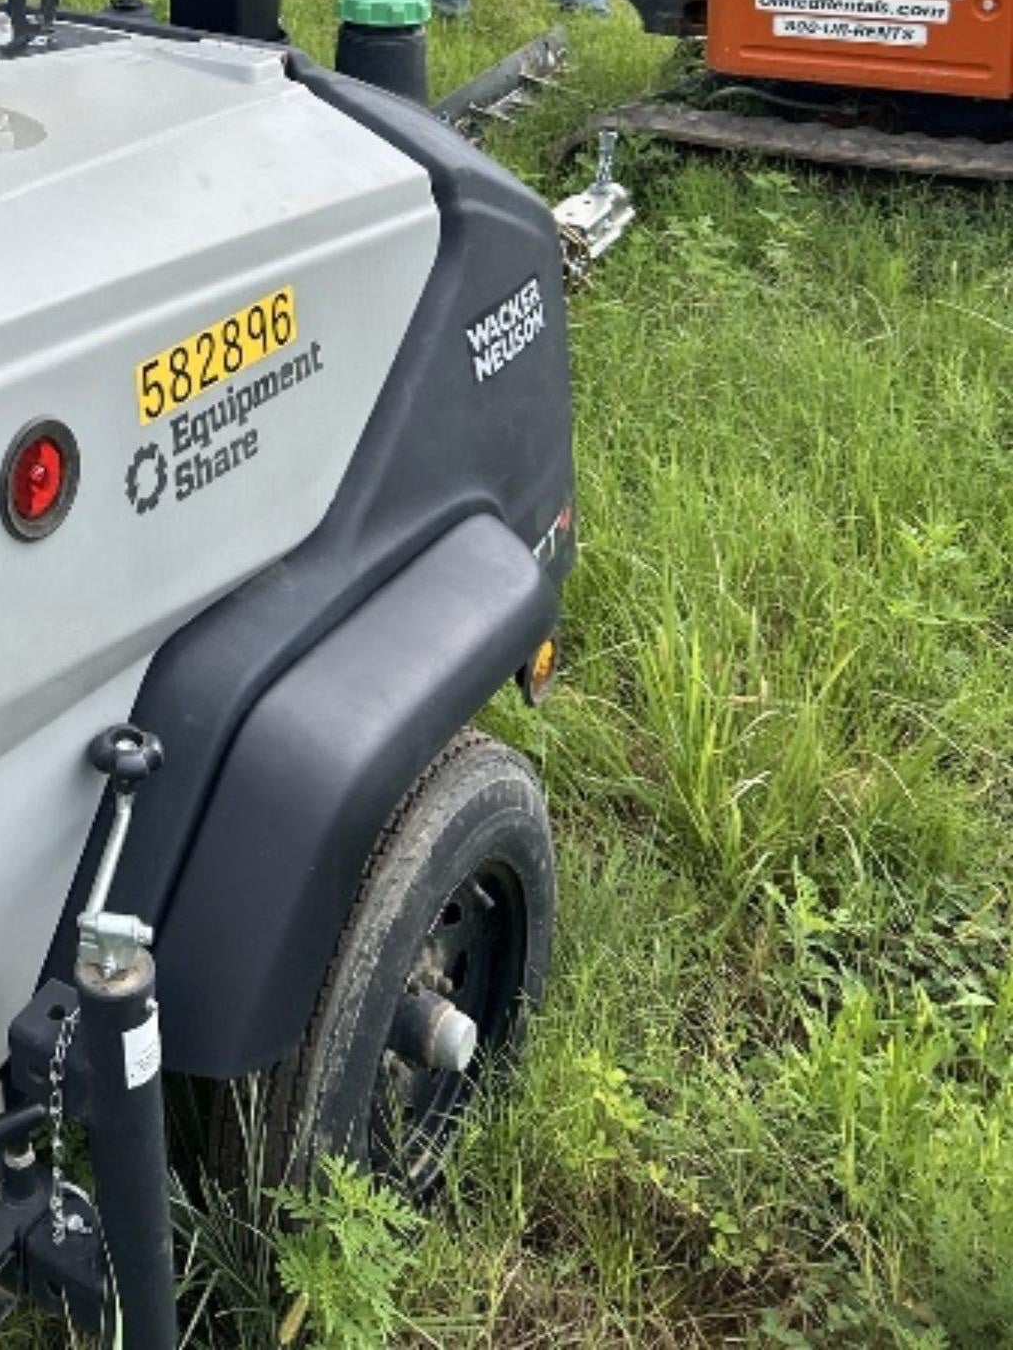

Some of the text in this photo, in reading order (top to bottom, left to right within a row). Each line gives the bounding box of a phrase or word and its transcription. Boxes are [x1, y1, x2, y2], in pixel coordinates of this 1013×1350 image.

[142, 292, 292, 418] 582896
[466, 278, 541, 352] WACKER
[473, 302, 546, 382] NEUSON
[169, 340, 325, 457] Equipment
[174, 427, 260, 502] Share
